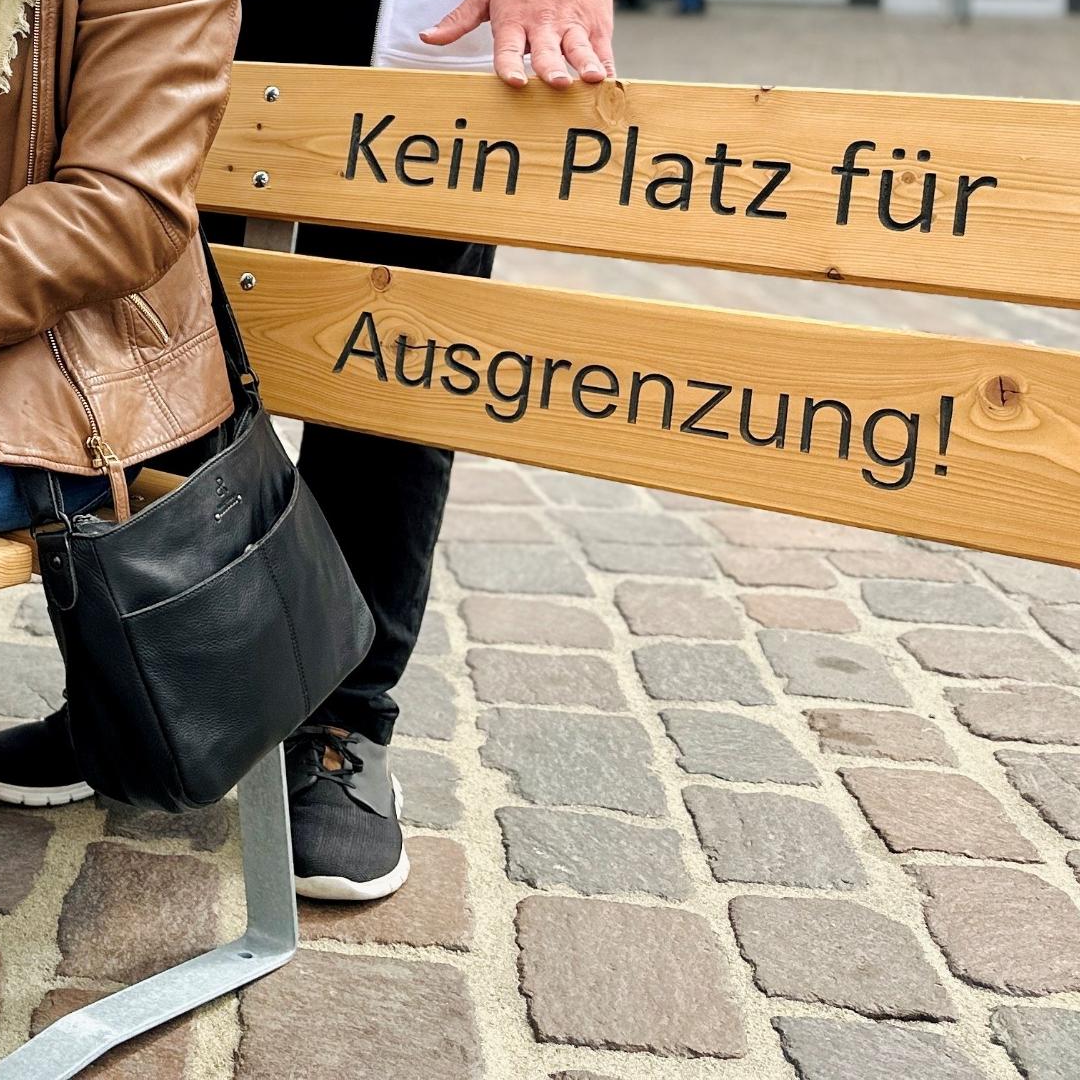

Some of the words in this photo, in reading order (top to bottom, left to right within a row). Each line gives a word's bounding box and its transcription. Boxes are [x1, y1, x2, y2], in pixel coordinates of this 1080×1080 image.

[345, 112, 520, 196] Kein
[558, 125, 793, 220] Platz
[831, 140, 998, 237] für
[332, 311, 955, 491] Ausgrenzung!
